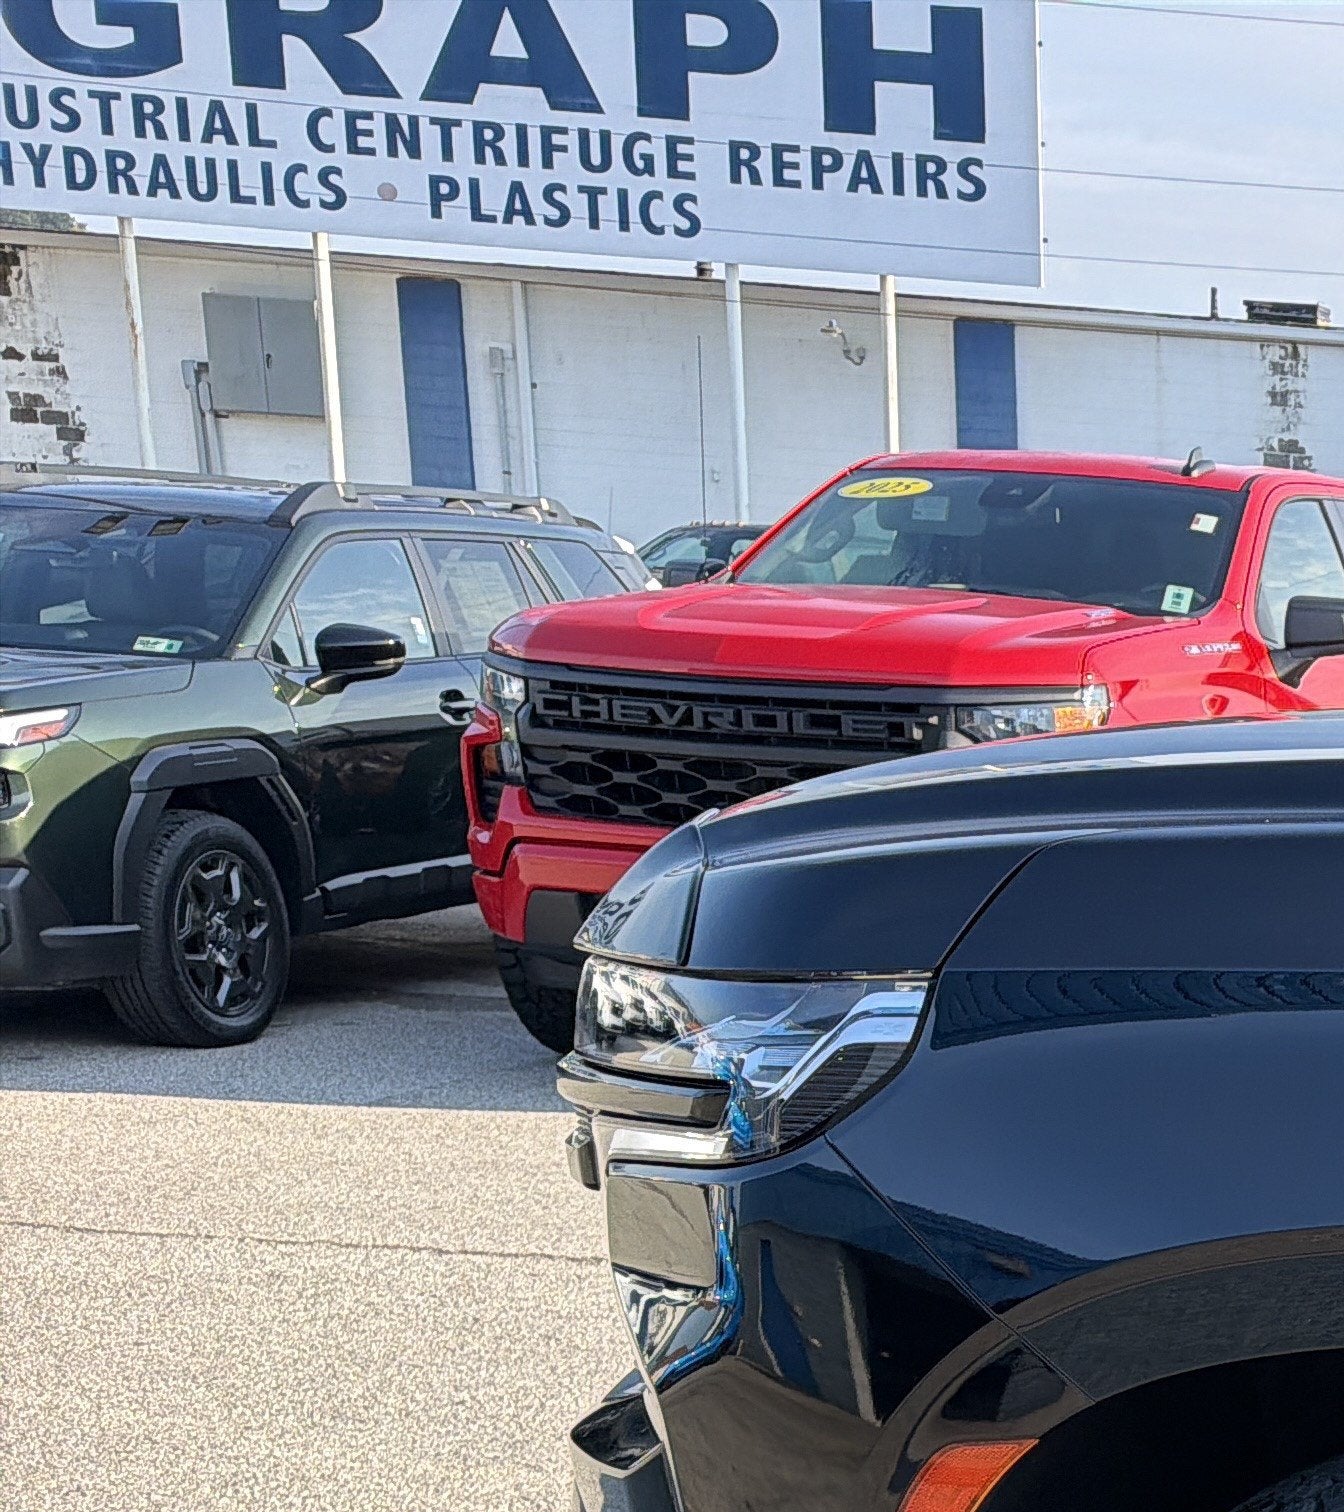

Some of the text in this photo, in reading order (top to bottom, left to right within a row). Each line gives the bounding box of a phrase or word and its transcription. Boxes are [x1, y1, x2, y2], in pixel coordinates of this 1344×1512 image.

[1, 82, 987, 203] USTRIAL CENTRIFUGE REPAIRS
[427, 173, 702, 239] PLASTICS
[534, 691, 938, 742] CHEVROLET
